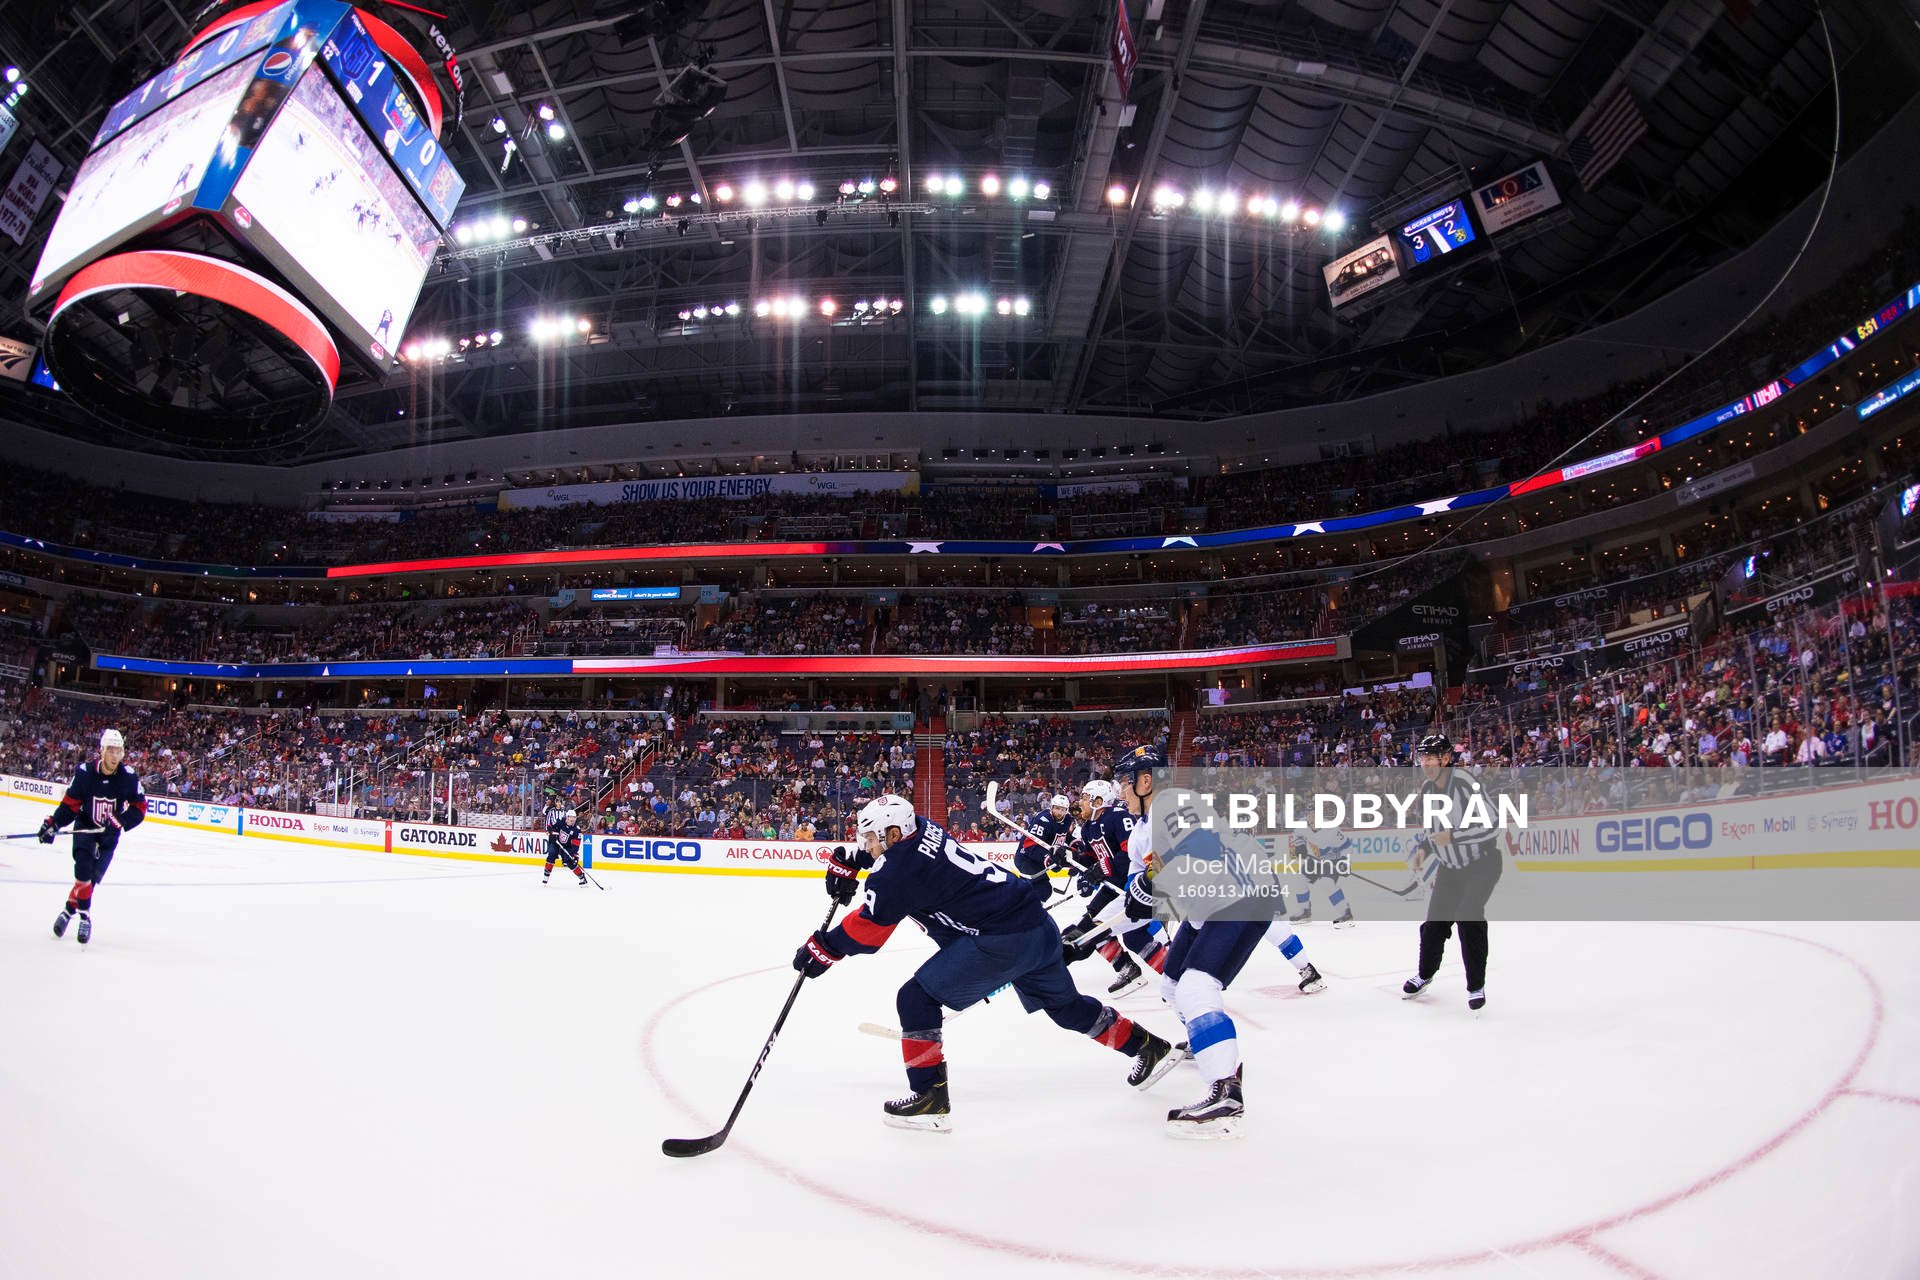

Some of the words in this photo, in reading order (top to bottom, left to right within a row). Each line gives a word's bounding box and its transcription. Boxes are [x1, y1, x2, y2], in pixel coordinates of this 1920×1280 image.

[367, 60, 386, 87] 1
[420, 139, 437, 166] 0
[1413, 235, 1424, 250] 3
[1444, 220, 1456, 236] 2
[1832, 344, 1840, 358] 1
[1733, 403, 1746, 415] 12
[622, 482, 659, 501] SHOW
[662, 482, 678, 499] US
[682, 480, 715, 497] YOUR
[719, 478, 772, 496] ENERGY
[817, 482, 837, 490] WGL
[1555, 589, 1609, 607] ETIHAD
[1766, 587, 1815, 612] ETIHAD
[1412, 605, 1459, 617] ETIHAD
[1399, 633, 1440, 645] ETIHAD
[1407, 642, 1433, 650] AIRWAYS
[1624, 632, 1672, 652] ETIHAD
[1675, 627, 1689, 639] 107
[1514, 657, 1564, 674] ETIHAD
[13, 780, 53, 796] GATORADE
[146, 799, 178, 817] EICO
[1868, 797, 1920, 831] HO
[248, 814, 305, 831] HONDA
[313, 822, 330, 833] Exxon
[332, 824, 349, 833] Mobil
[359, 828, 380, 838] Synergy
[1031, 824, 1045, 837] 26
[1100, 823, 1106, 835] C
[1164, 806, 1200, 839] 55
[400, 828, 477, 847] GATORADE
[917, 820, 943, 860] PARISE
[1518, 829, 1579, 855] CANADIAN
[1596, 813, 1712, 852] GEICO
[1722, 822, 1755, 840] Exxon
[1764, 815, 1795, 833] Mobil
[1822, 815, 1858, 832] Synergy
[511, 836, 549, 855] CANAD
[601, 838, 701, 862] GEICO
[726, 847, 750, 860] AIR
[752, 848, 813, 862] CANADA
[987, 851, 1015, 863] Exxon
[828, 863, 852, 877] TON
[807, 941, 836, 966] EAST
